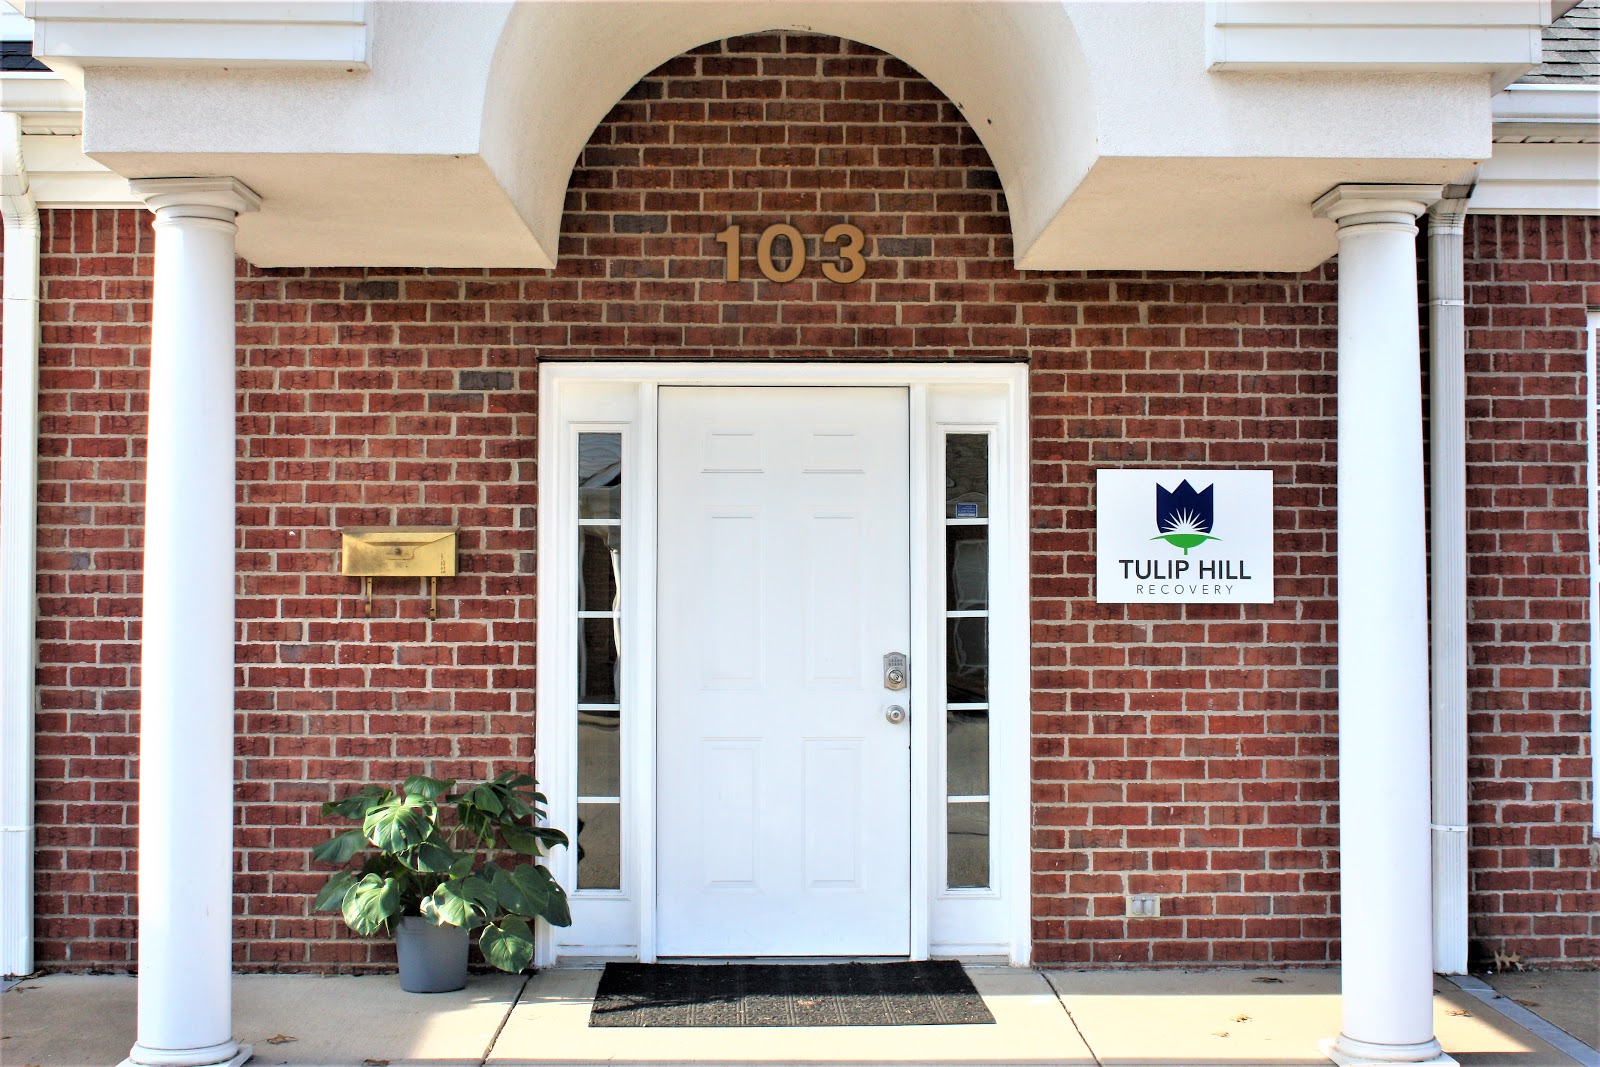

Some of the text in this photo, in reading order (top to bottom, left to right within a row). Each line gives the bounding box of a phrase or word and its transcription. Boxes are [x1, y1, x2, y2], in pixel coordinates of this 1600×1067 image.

[715, 224, 867, 284] 103
[1118, 559, 1252, 580] TULIP HILL
[1136, 584, 1234, 595] RECOVERY
